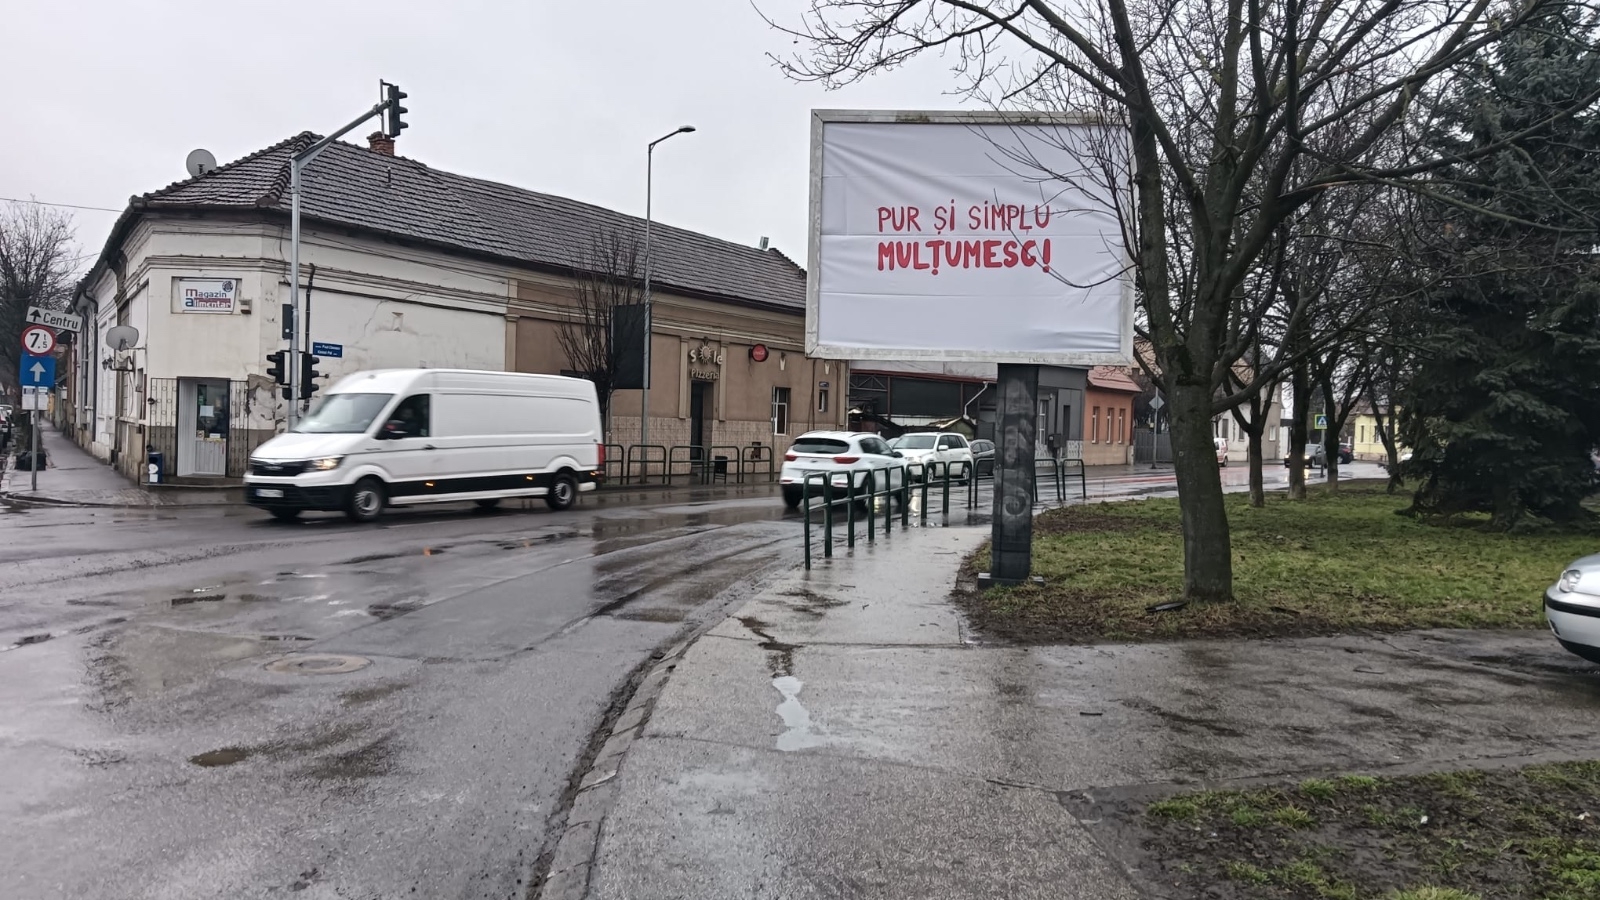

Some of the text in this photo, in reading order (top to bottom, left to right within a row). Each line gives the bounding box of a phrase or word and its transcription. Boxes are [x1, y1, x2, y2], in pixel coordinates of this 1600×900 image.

[878, 206, 921, 232] PUR
[878, 239, 1050, 275] MULȚUMESC!
[43, 312, 78, 329] Centru
[690, 368, 720, 380] Pizzeria
